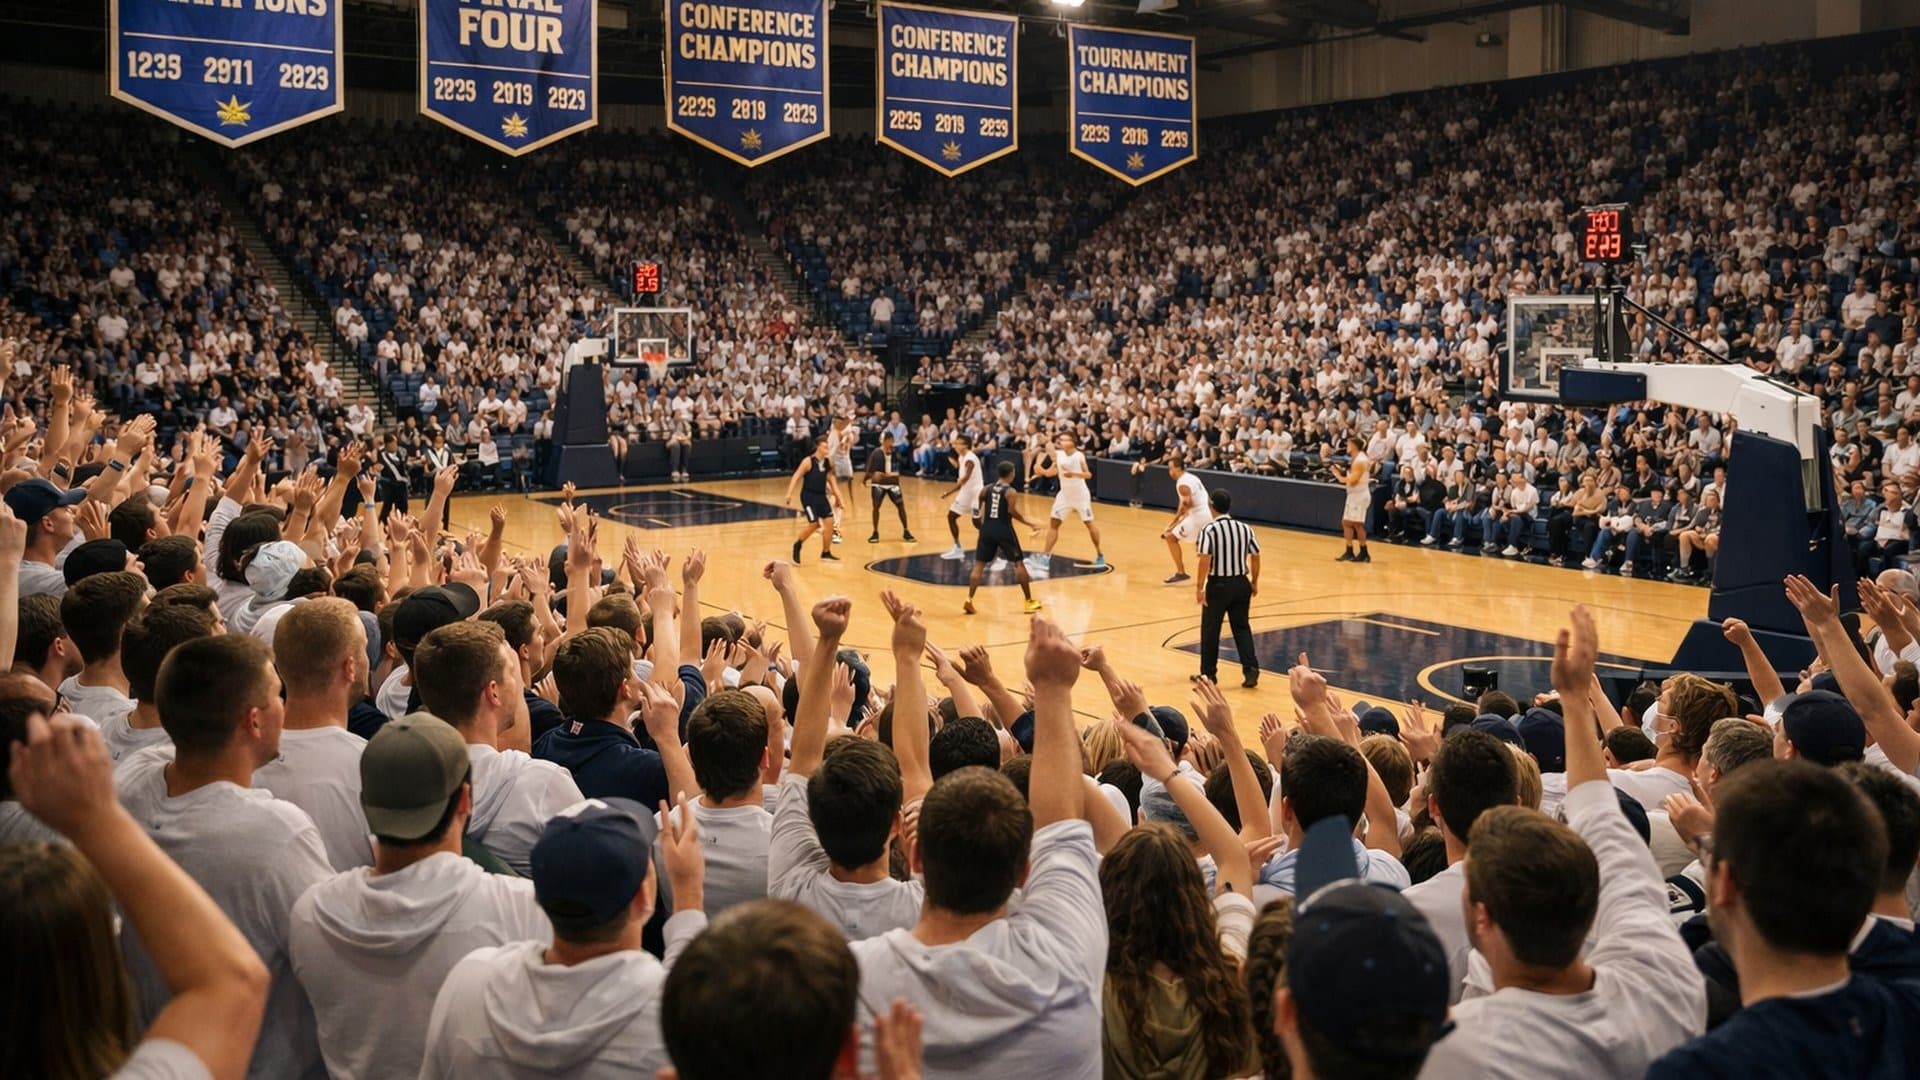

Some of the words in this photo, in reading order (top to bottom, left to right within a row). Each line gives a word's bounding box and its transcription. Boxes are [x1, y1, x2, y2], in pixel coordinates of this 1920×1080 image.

[459, 8, 563, 54] FOUR
[681, 3, 815, 38] CONFERENCE
[681, 33, 816, 69] CHAMPIONS
[892, 24, 1006, 57] CONFERENCE
[892, 53, 1007, 86] CHAMPIONS
[1078, 45, 1187, 73] TOURNAMENT
[1080, 71, 1188, 100] CHAMPIONS
